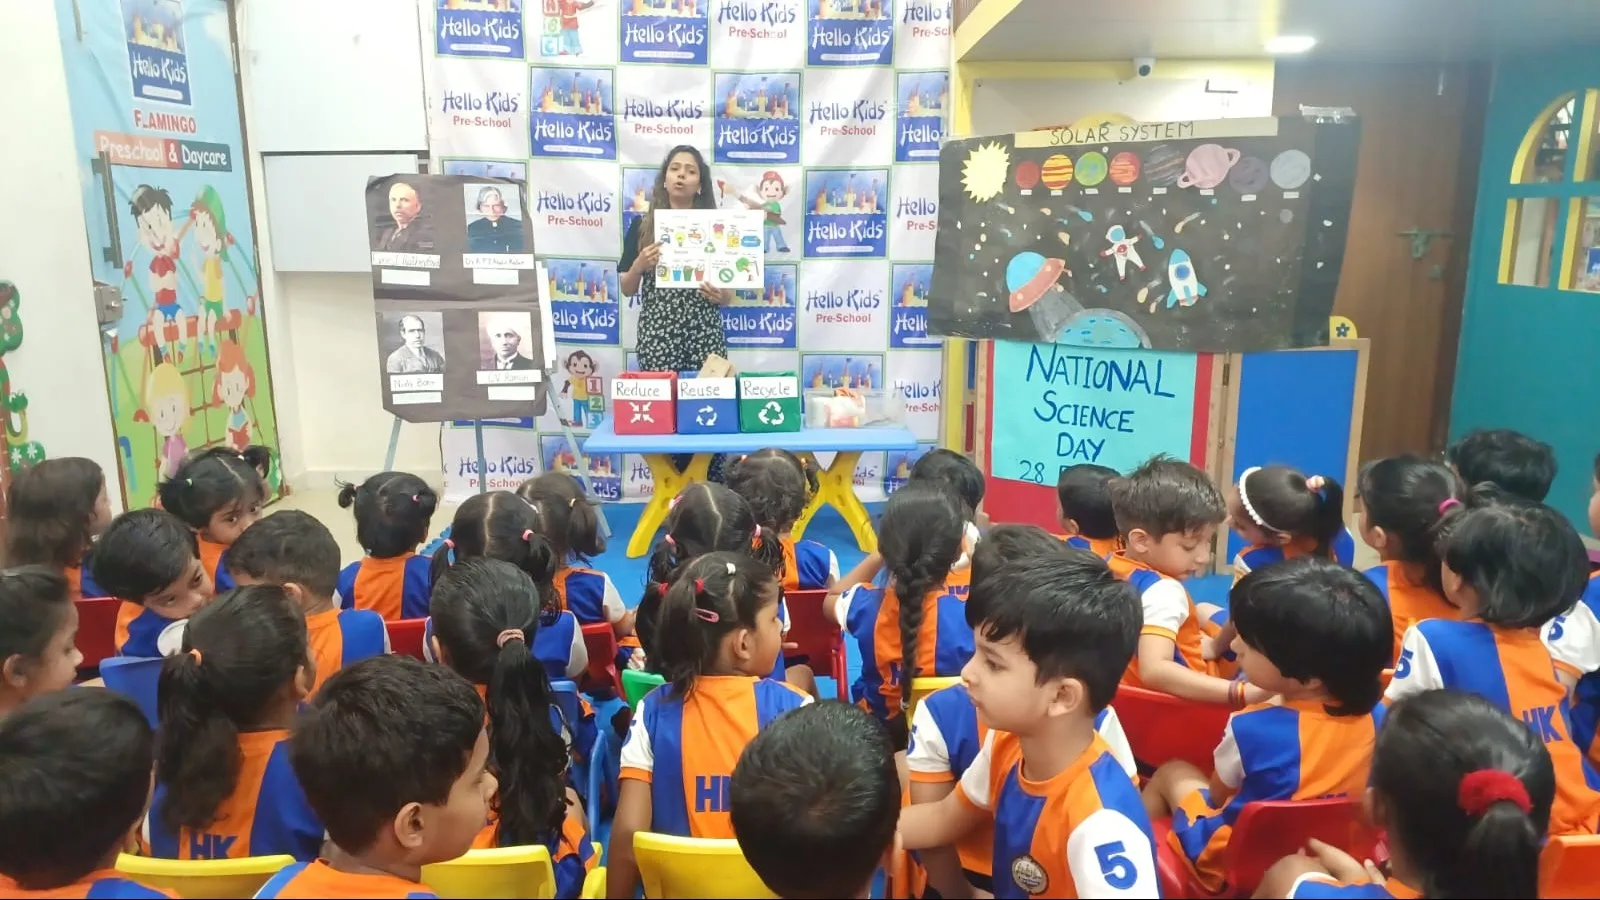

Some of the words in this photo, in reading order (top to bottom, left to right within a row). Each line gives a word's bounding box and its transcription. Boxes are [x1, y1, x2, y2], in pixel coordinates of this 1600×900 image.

[718, 1, 757, 25] Hello
[760, 2, 796, 28] Kids
[903, 0, 942, 25] Hello
[441, 16, 480, 40] Hello
[482, 18, 519, 41] Kids
[625, 22, 665, 47] Hello
[667, 23, 704, 48] Kids
[813, 26, 852, 50] Hello
[854, 27, 890, 50] Kids
[132, 51, 160, 78] Hello
[160, 57, 187, 85] Kids
[442, 89, 482, 114] Hello
[486, 91, 518, 115] Kids
[624, 98, 663, 120] Hello
[664, 99, 702, 122] Kids
[809, 101, 848, 124] Hello
[852, 100, 885, 123] Kids
[453, 115, 512, 128] Pre-School
[534, 118, 572, 141] Hello
[577, 121, 612, 144] Kids
[634, 123, 694, 135] Pre-School
[820, 125, 876, 136] Pre-School
[718, 123, 757, 148] Hello
[761, 125, 797, 149] Kids
[900, 124, 940, 147] Hello
[1050, 124, 1111, 147] SOLAR
[1119, 121, 1195, 143] SYSTEM
[99, 135, 164, 162] Preschool
[168, 143, 178, 164] &
[181, 144, 228, 170] Daycare
[536, 190, 574, 213] Hello
[577, 191, 611, 215] Kids
[897, 196, 936, 219] Hello
[547, 215, 604, 228] Pre-School
[808, 221, 847, 243] Hello
[850, 220, 883, 242] Kids
[805, 290, 843, 312] Hello
[846, 289, 880, 311] Kids
[553, 308, 578, 326] ello
[581, 308, 616, 330] Kids
[721, 313, 757, 332] Hello
[759, 313, 793, 334] Kids
[816, 313, 871, 324] Pre-School
[1026, 341, 1175, 398] NATIONAL
[616, 381, 660, 397] Reduce
[680, 382, 720, 397] Reuse
[743, 379, 791, 399] Recycle
[1034, 390, 1135, 433] SCIENCE
[1056, 432, 1106, 463] DAY
[459, 456, 497, 477] Helo
[500, 456, 534, 477] Kids
[1019, 460, 1045, 484] 28
[1094, 840, 1138, 890] 5
